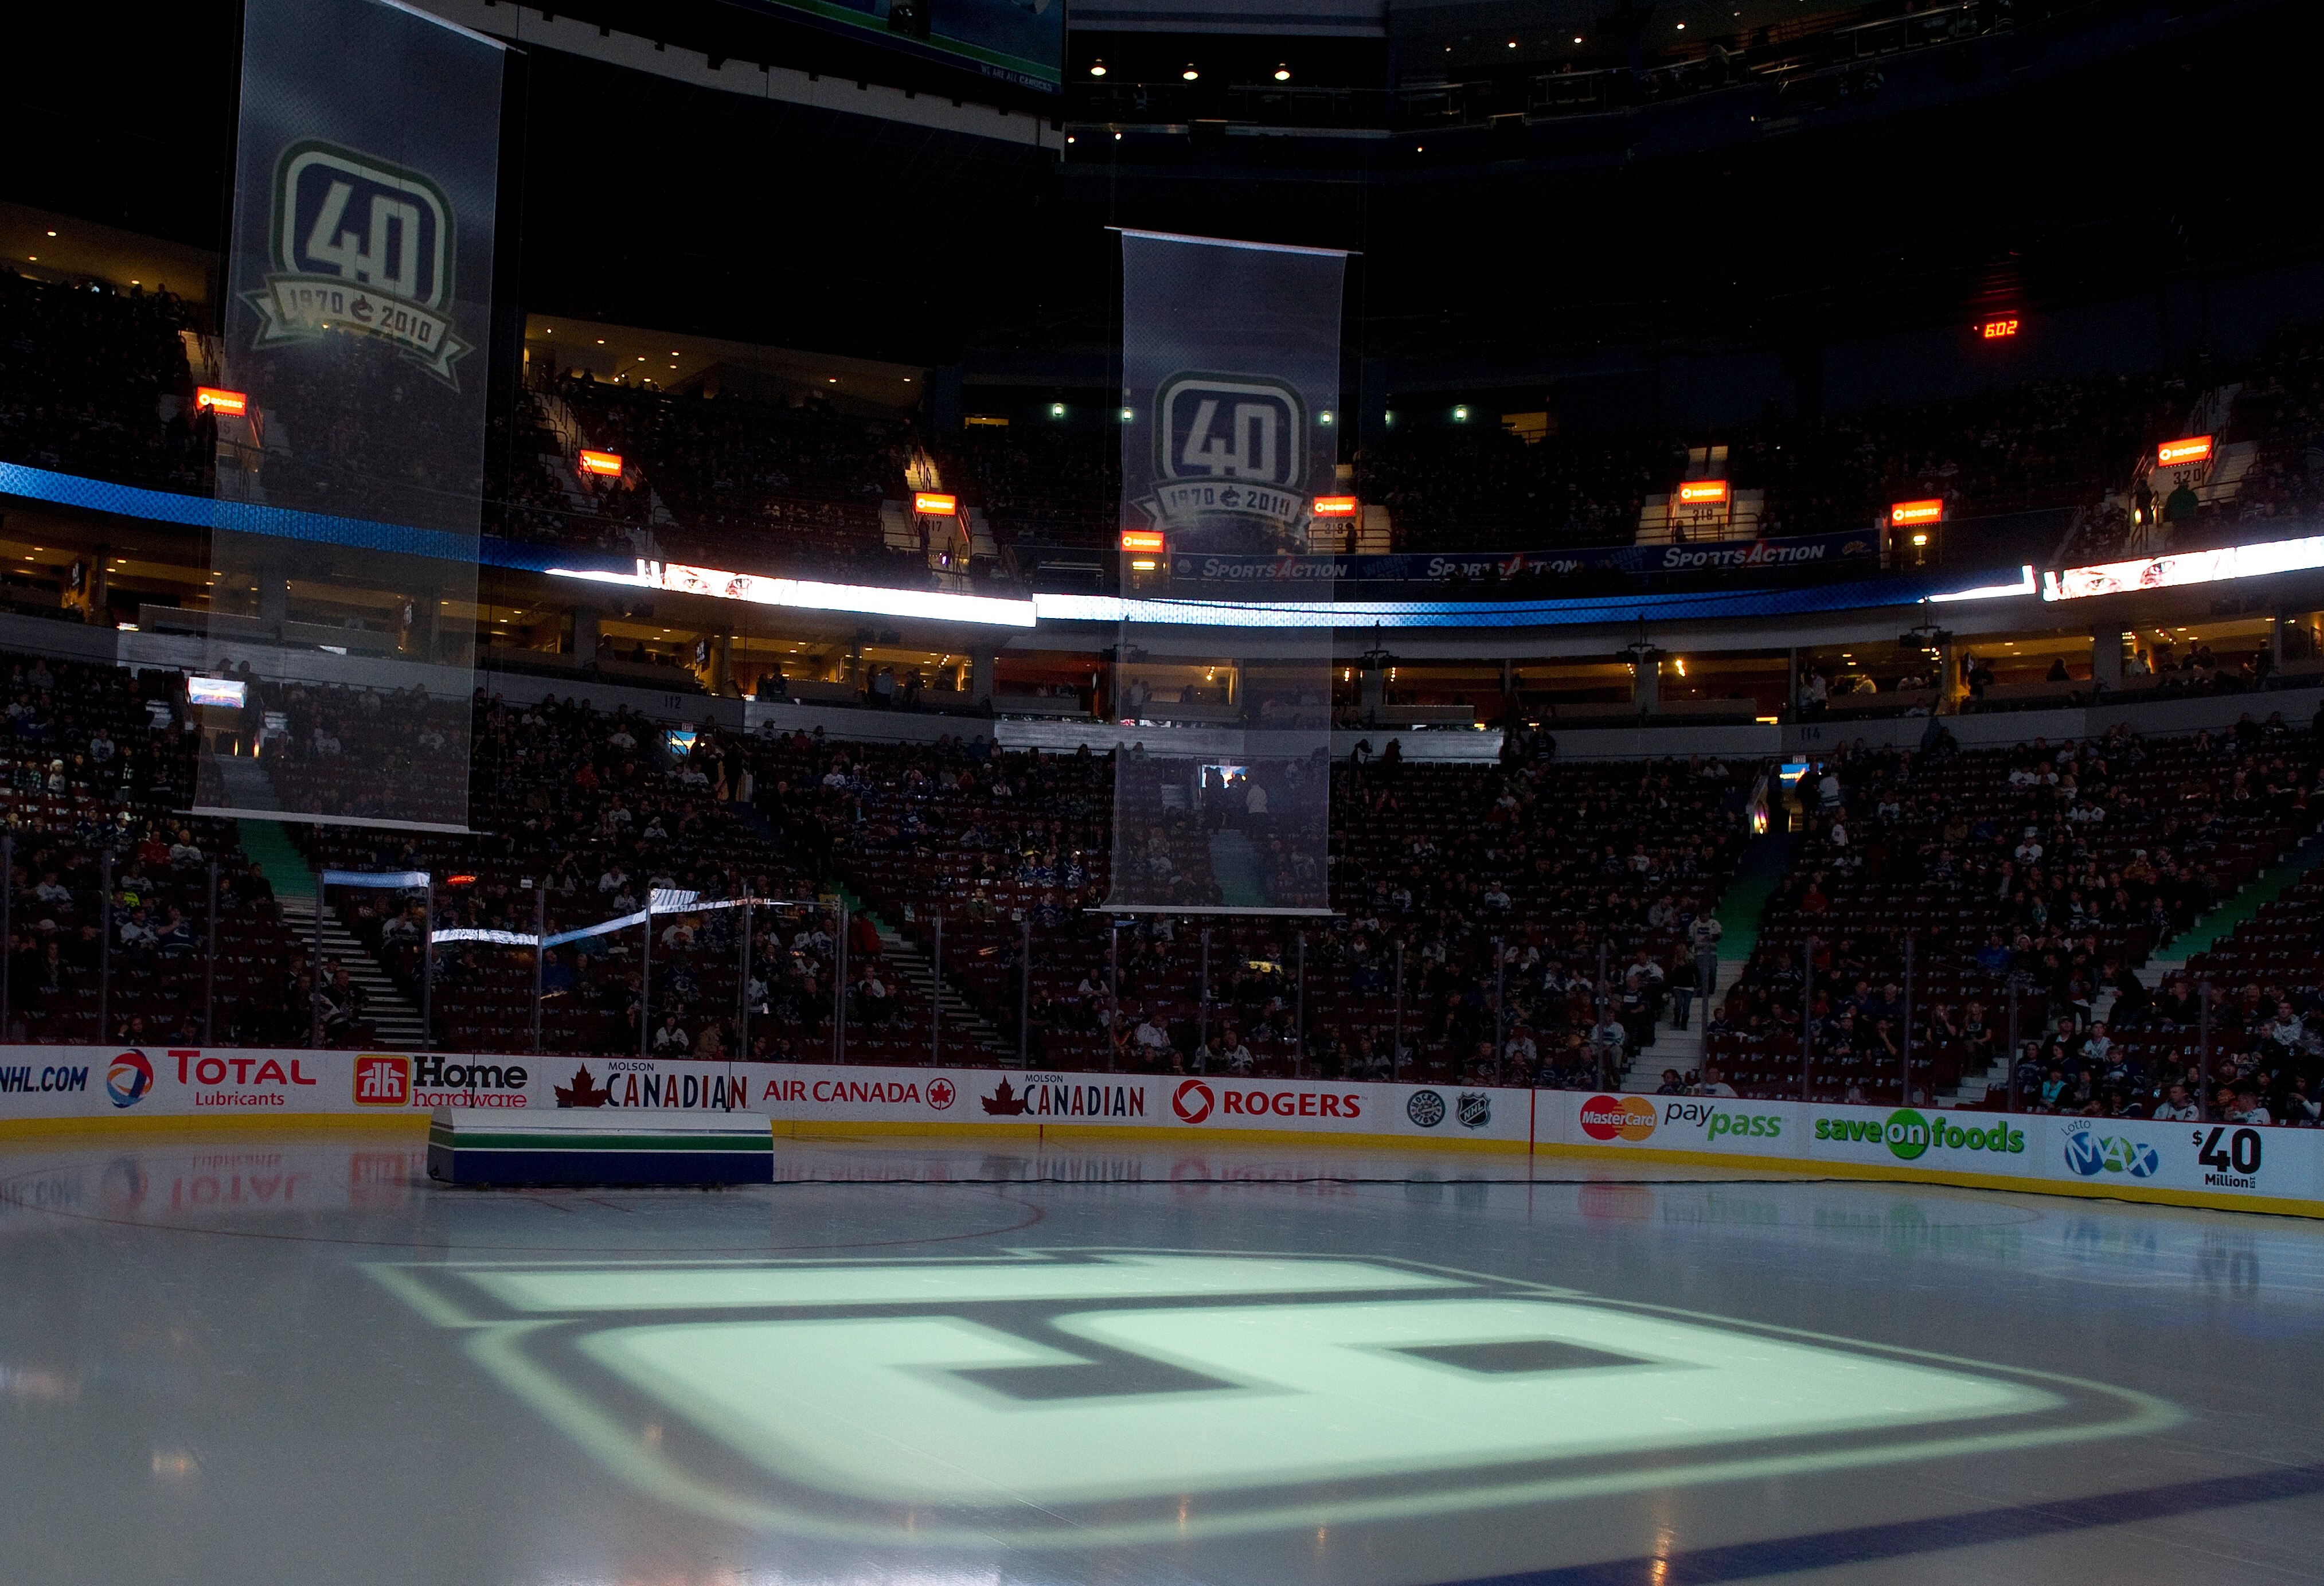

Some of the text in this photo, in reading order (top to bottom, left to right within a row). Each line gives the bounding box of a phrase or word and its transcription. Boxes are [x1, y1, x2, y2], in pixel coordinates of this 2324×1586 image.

[1018, 75, 1052, 92] CANUCKS
[306, 179, 420, 298] 40
[290, 289, 432, 343] 1970 2010
[211, 397, 243, 408] ROGERS
[1182, 400, 1276, 481] 40
[2172, 445, 2207, 457] ROGERS
[592, 459, 619, 470] ROGERS
[2174, 468, 2201, 485] 320
[1692, 489, 1723, 497] ROGERS
[927, 501, 952, 509] ROGERS
[1170, 488, 1290, 516] 1970 2010
[1905, 507, 1938, 518] ROGERS
[1133, 538, 1160, 546] ROGERS
[665, 695, 681, 709] 112
[1801, 727, 1820, 740] 114
[168, 1050, 316, 1085] TOTAL
[413, 1056, 528, 1088] Home
[608, 1062, 654, 1071] MOLSON
[1025, 1074, 1063, 1083] MOLSON
[196, 1091, 284, 1106] Lubricants
[412, 1089, 527, 1108] hardware
[607, 1073, 747, 1110] CANADIAN
[763, 1080, 921, 1103] AIR CANADA
[1024, 1084, 1145, 1117] CANADIAN
[1224, 1091, 1361, 1118] ROGERS
[1411, 1093, 1441, 1108] HOCKEY
[1413, 1112, 1440, 1124] NIGHT
[1463, 1101, 1484, 1121] NHL
[1581, 1111, 1655, 1127] MasterCard
[1665, 1102, 1782, 1141] pay pass
[2061, 1119, 2091, 1136] Lotto
[2065, 1134, 2157, 1177] MAX
[2205, 1173, 2248, 1189] Million
